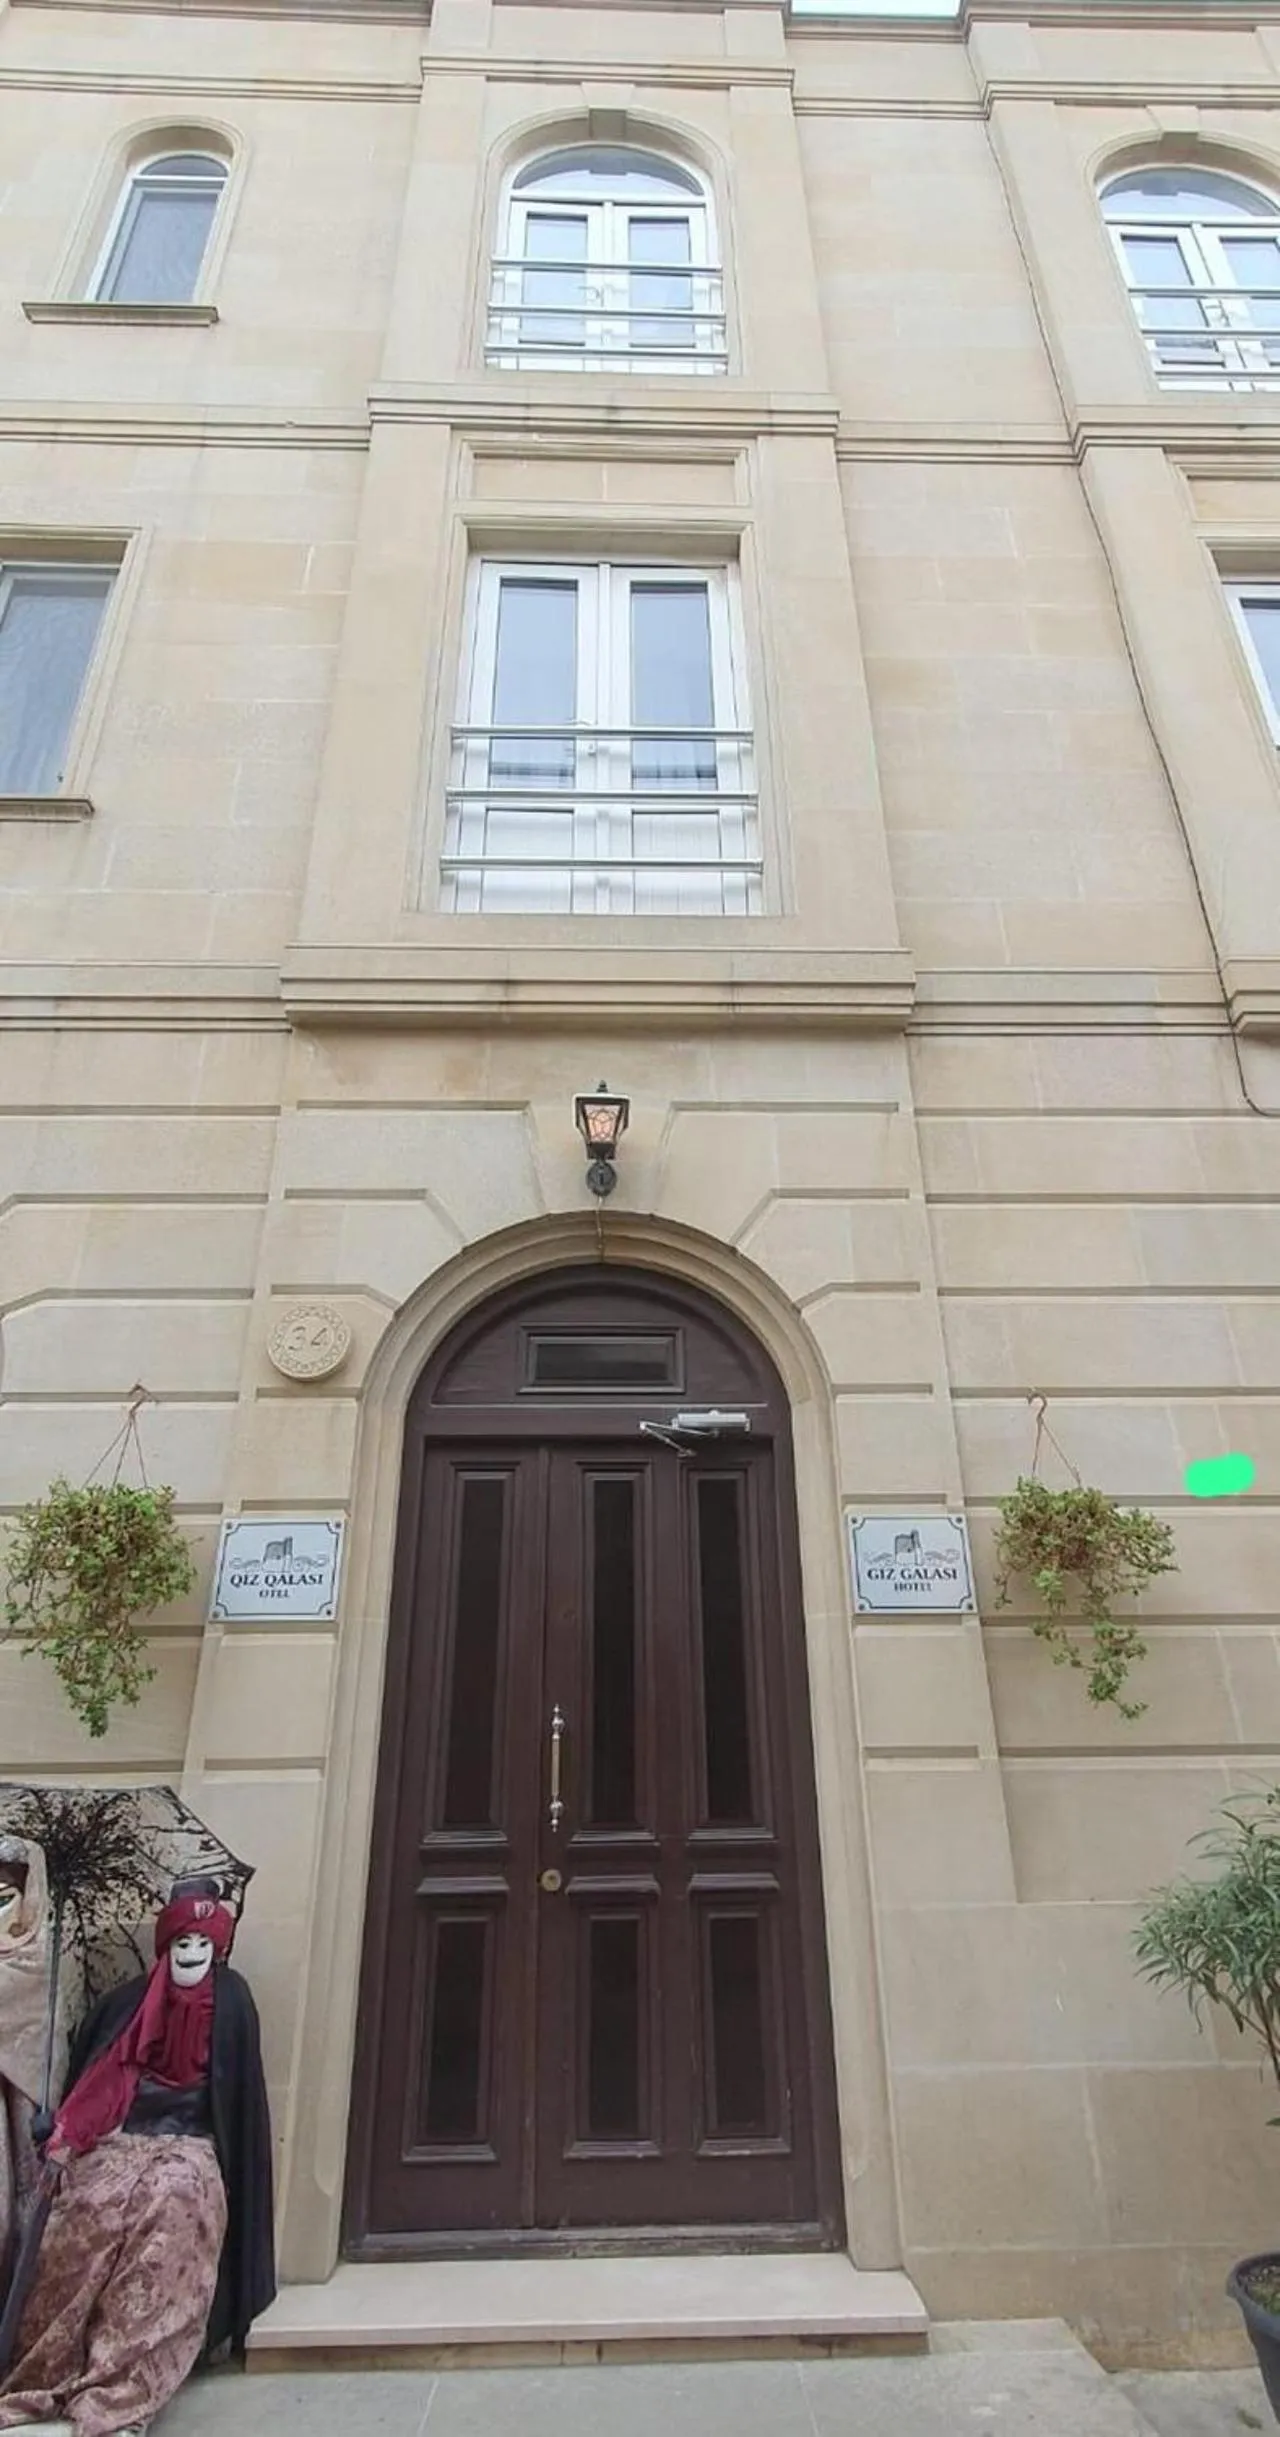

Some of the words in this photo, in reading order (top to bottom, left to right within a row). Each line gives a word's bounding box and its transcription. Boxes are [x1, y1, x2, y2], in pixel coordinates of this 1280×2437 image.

[287, 1325, 329, 1352] 34
[867, 1567, 895, 1580] GIZ
[900, 1567, 957, 1580] GALASI
[230, 1573, 259, 1588] QIZ
[264, 1573, 323, 1587] QALASI
[894, 1582, 932, 1592] HOTEL
[259, 1589, 290, 1598] OTEL
